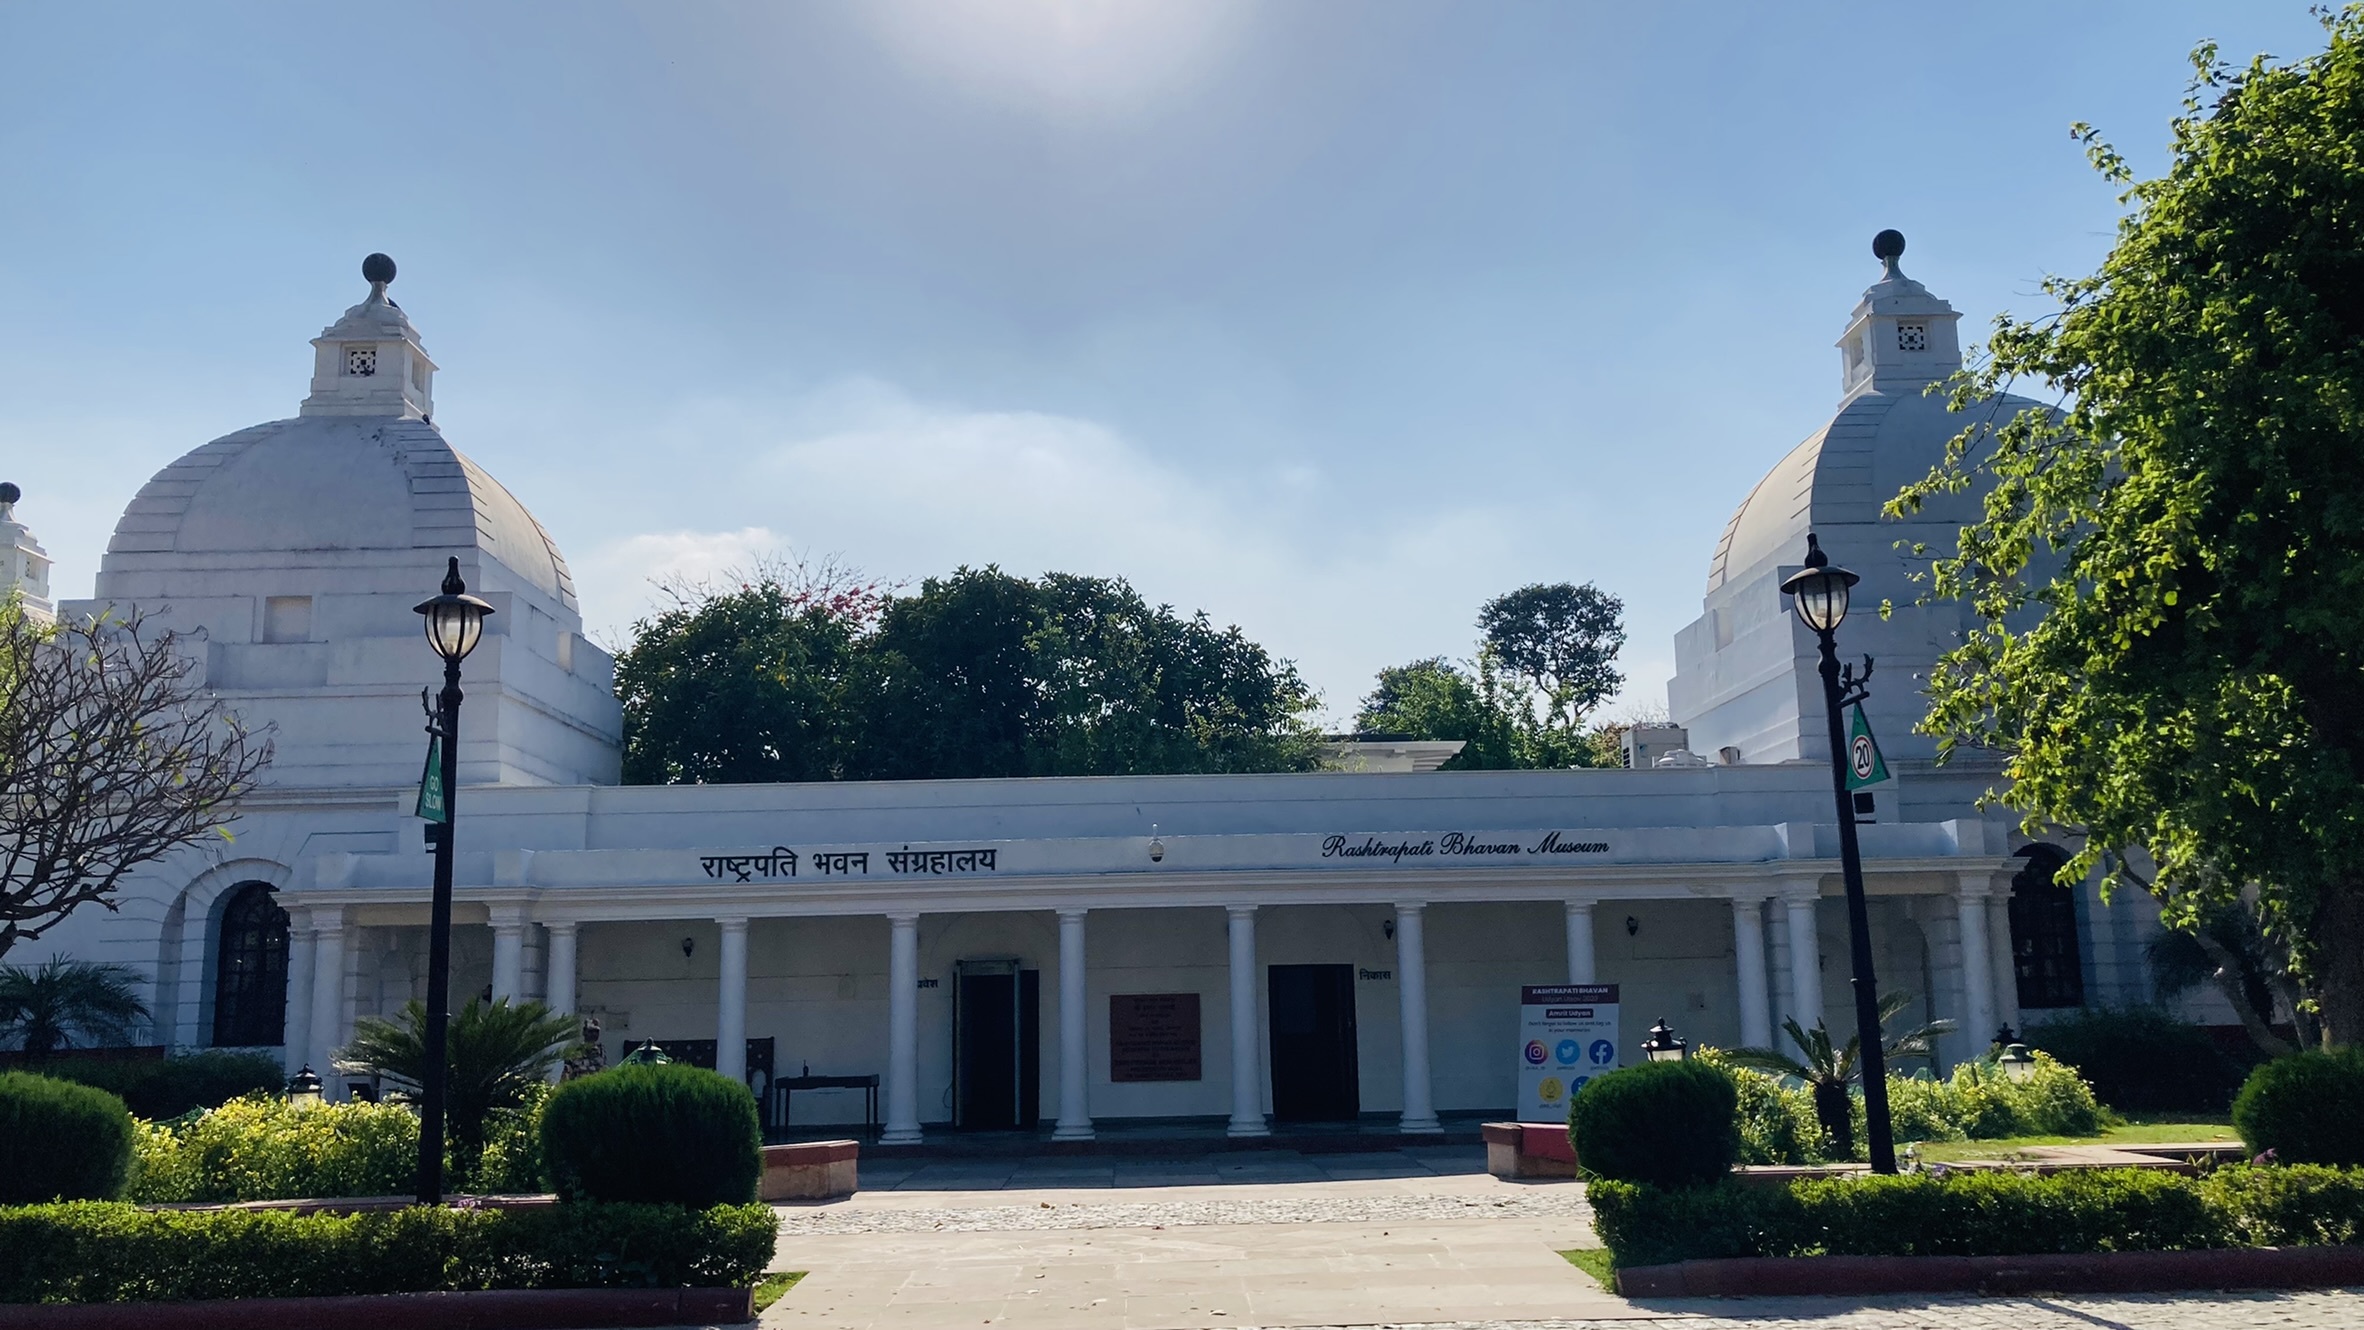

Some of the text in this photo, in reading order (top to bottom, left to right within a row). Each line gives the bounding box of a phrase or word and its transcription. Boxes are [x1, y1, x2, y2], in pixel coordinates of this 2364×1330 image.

[1855, 743, 1870, 770] 20
[429, 775, 439, 792] GO
[425, 792, 442, 811] SLOW
[1321, 831, 1610, 864] Rashtrapati Bhavan Museum
[700, 845, 997, 883] राष्ट्रपति भवन संग्रहालय
[1359, 967, 1392, 980] निकास
[1569, 1010, 1591, 1018] Udyan
